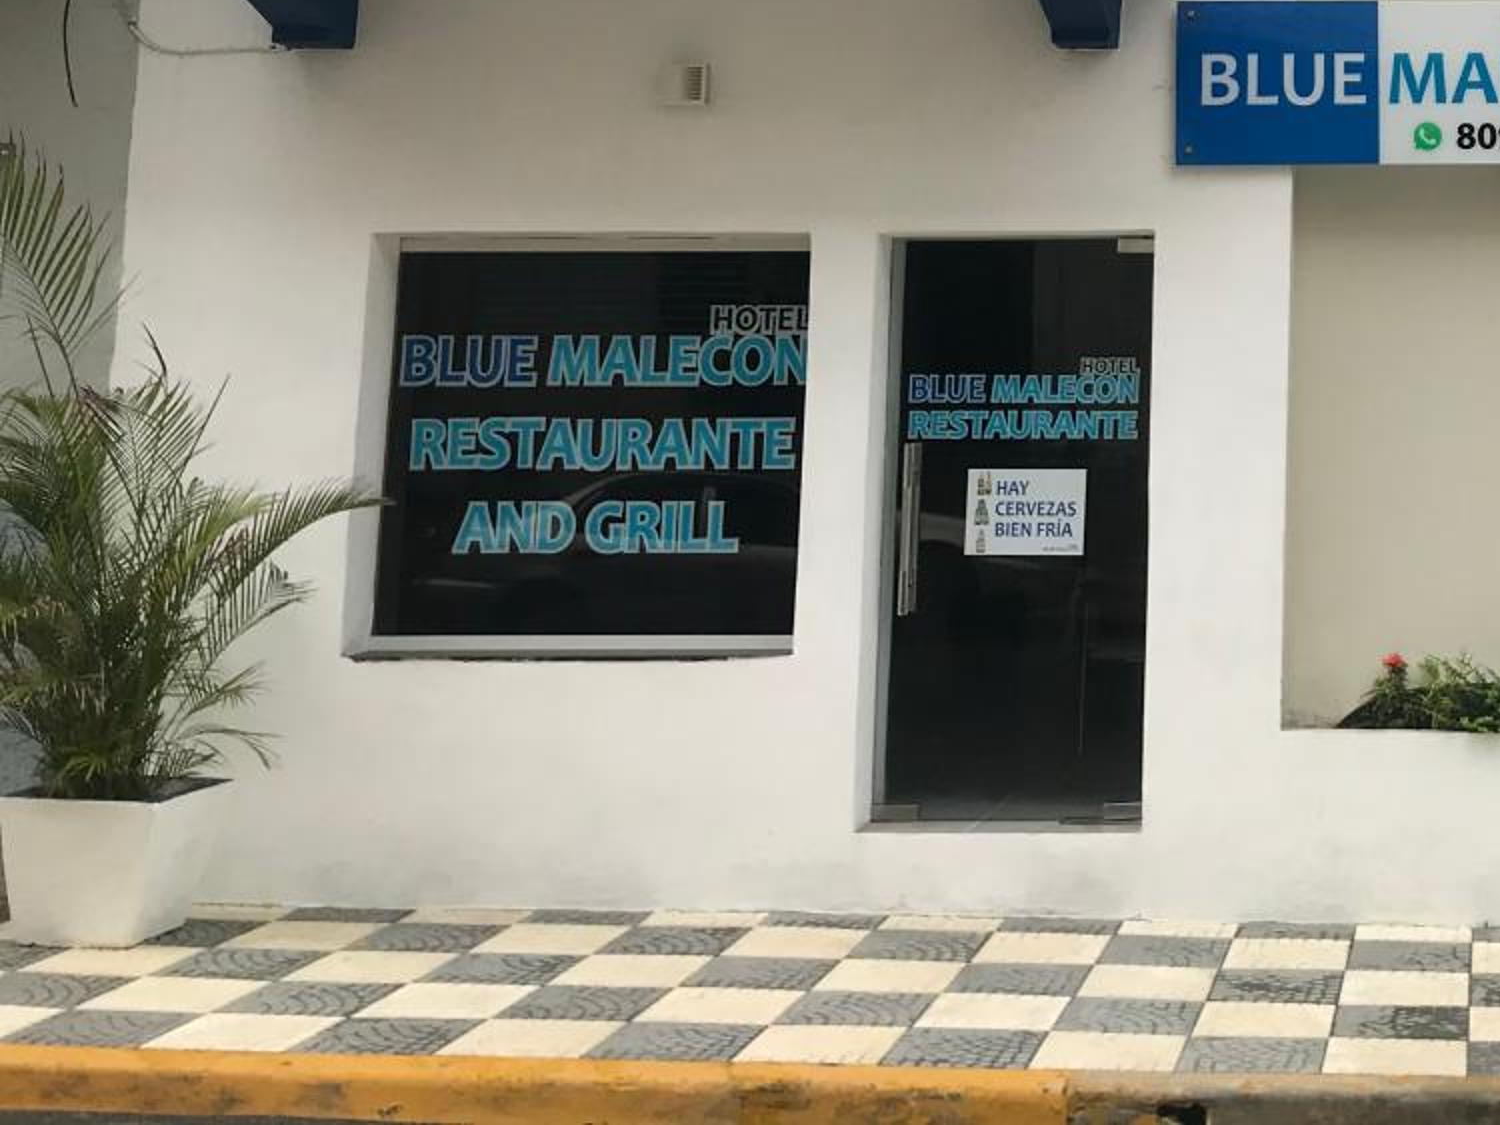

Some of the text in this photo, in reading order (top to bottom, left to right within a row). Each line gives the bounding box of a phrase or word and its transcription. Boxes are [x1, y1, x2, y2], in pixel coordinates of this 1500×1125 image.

[1200, 53, 1368, 107] BLUE
[710, 305, 807, 335] HOTEL
[400, 334, 807, 387] BLUE MALECON
[1080, 357, 1140, 375] HOTEL
[908, 374, 1140, 404] BLUE MALECON
[907, 410, 1139, 440] RESTAURANTE
[409, 416, 797, 472] RESTAURANTE
[996, 480, 1029, 496] HAY
[995, 501, 1077, 517] CERVEZAS
[452, 500, 740, 555] AND GRILL
[995, 518, 1073, 537] BIEN FRÍA
